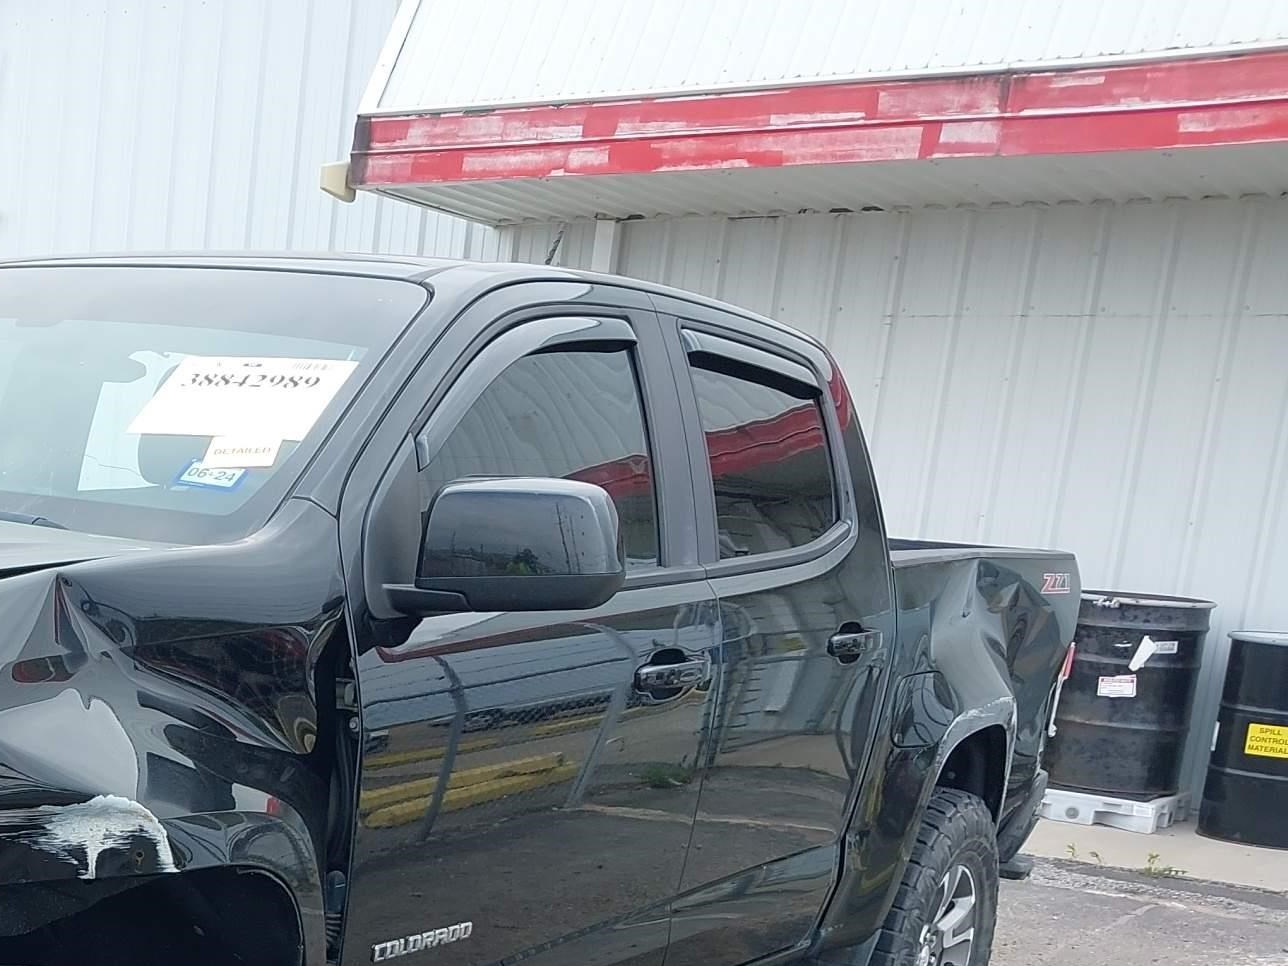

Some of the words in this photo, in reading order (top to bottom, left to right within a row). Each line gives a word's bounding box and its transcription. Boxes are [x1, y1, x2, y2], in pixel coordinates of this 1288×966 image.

[181, 373, 321, 389] 38842989
[1040, 573, 1071, 594] Z71
[1259, 727, 1283, 736] SPILL
[1249, 735, 1288, 746] CONTROL
[372, 921, 473, 963] COLORADO
